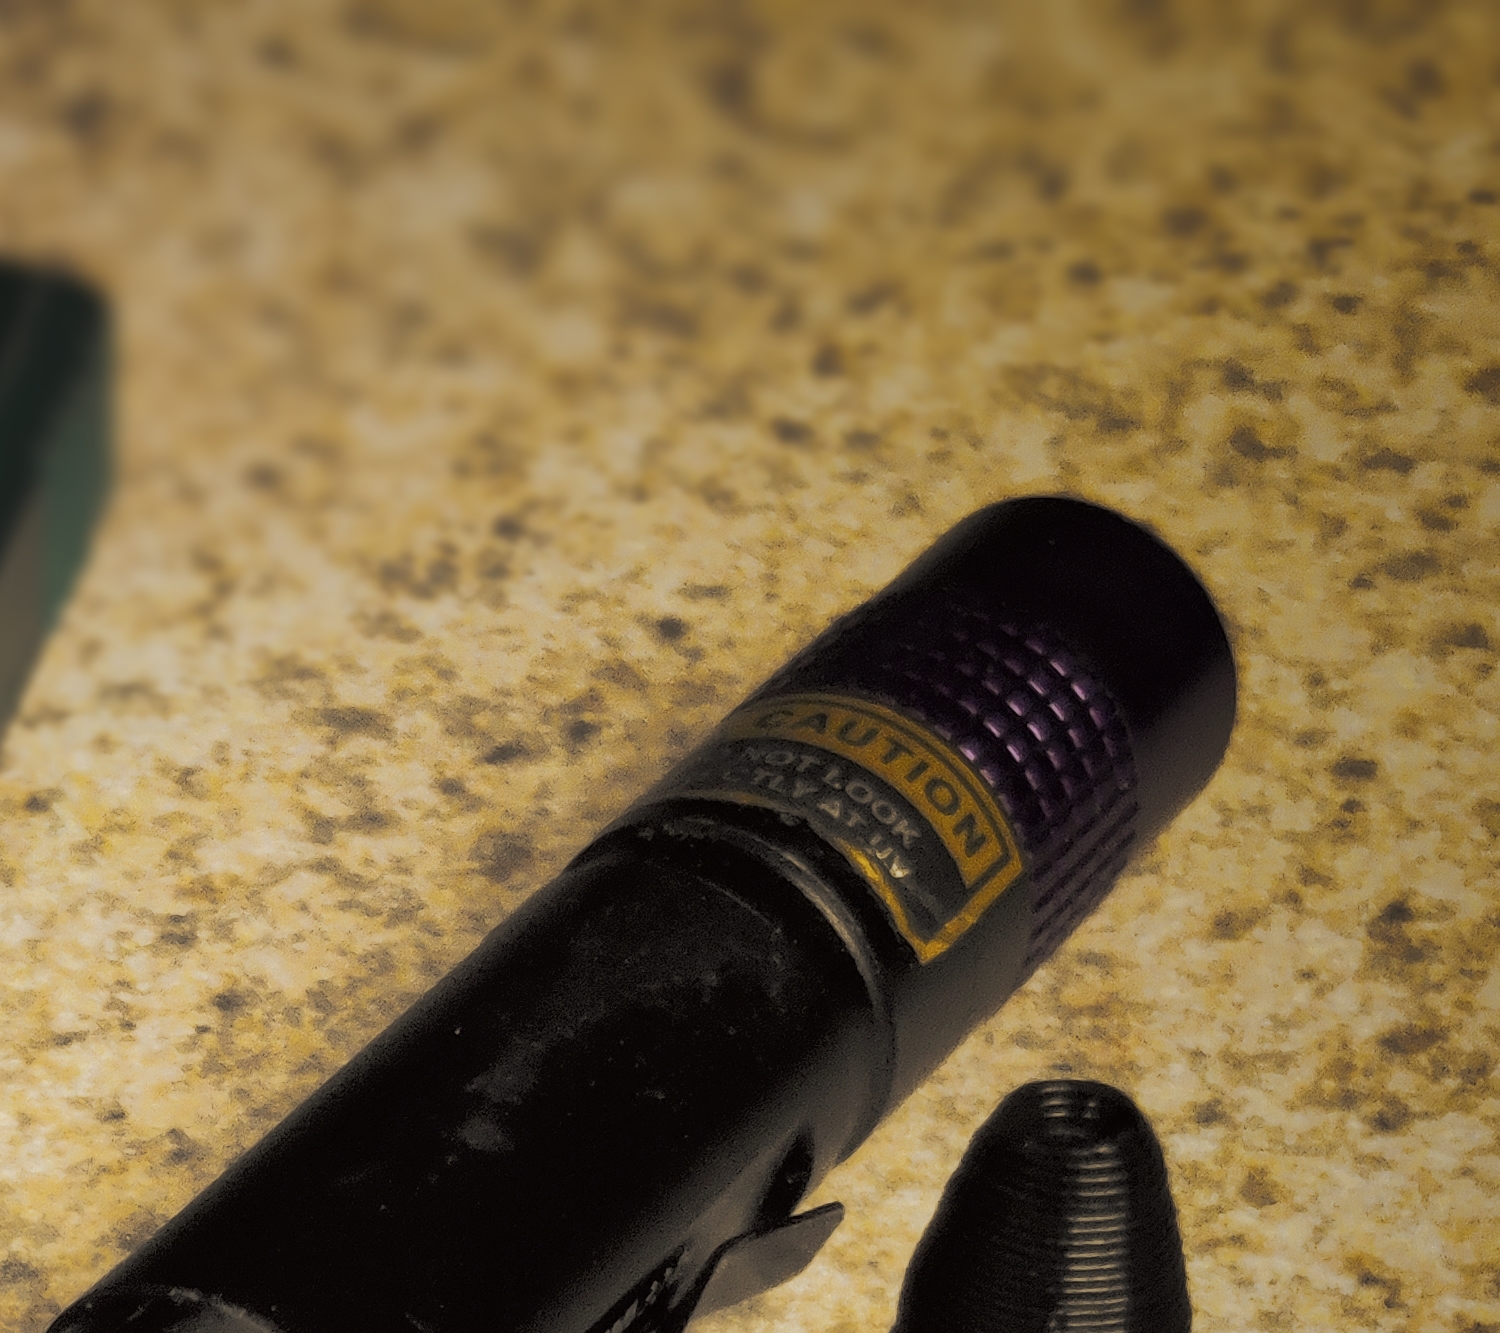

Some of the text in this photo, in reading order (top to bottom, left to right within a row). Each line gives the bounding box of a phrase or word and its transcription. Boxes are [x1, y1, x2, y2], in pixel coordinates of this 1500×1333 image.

[754, 709, 988, 859] CAUTION
[815, 796, 867, 828] AT
[822, 765, 923, 849] LOOK
